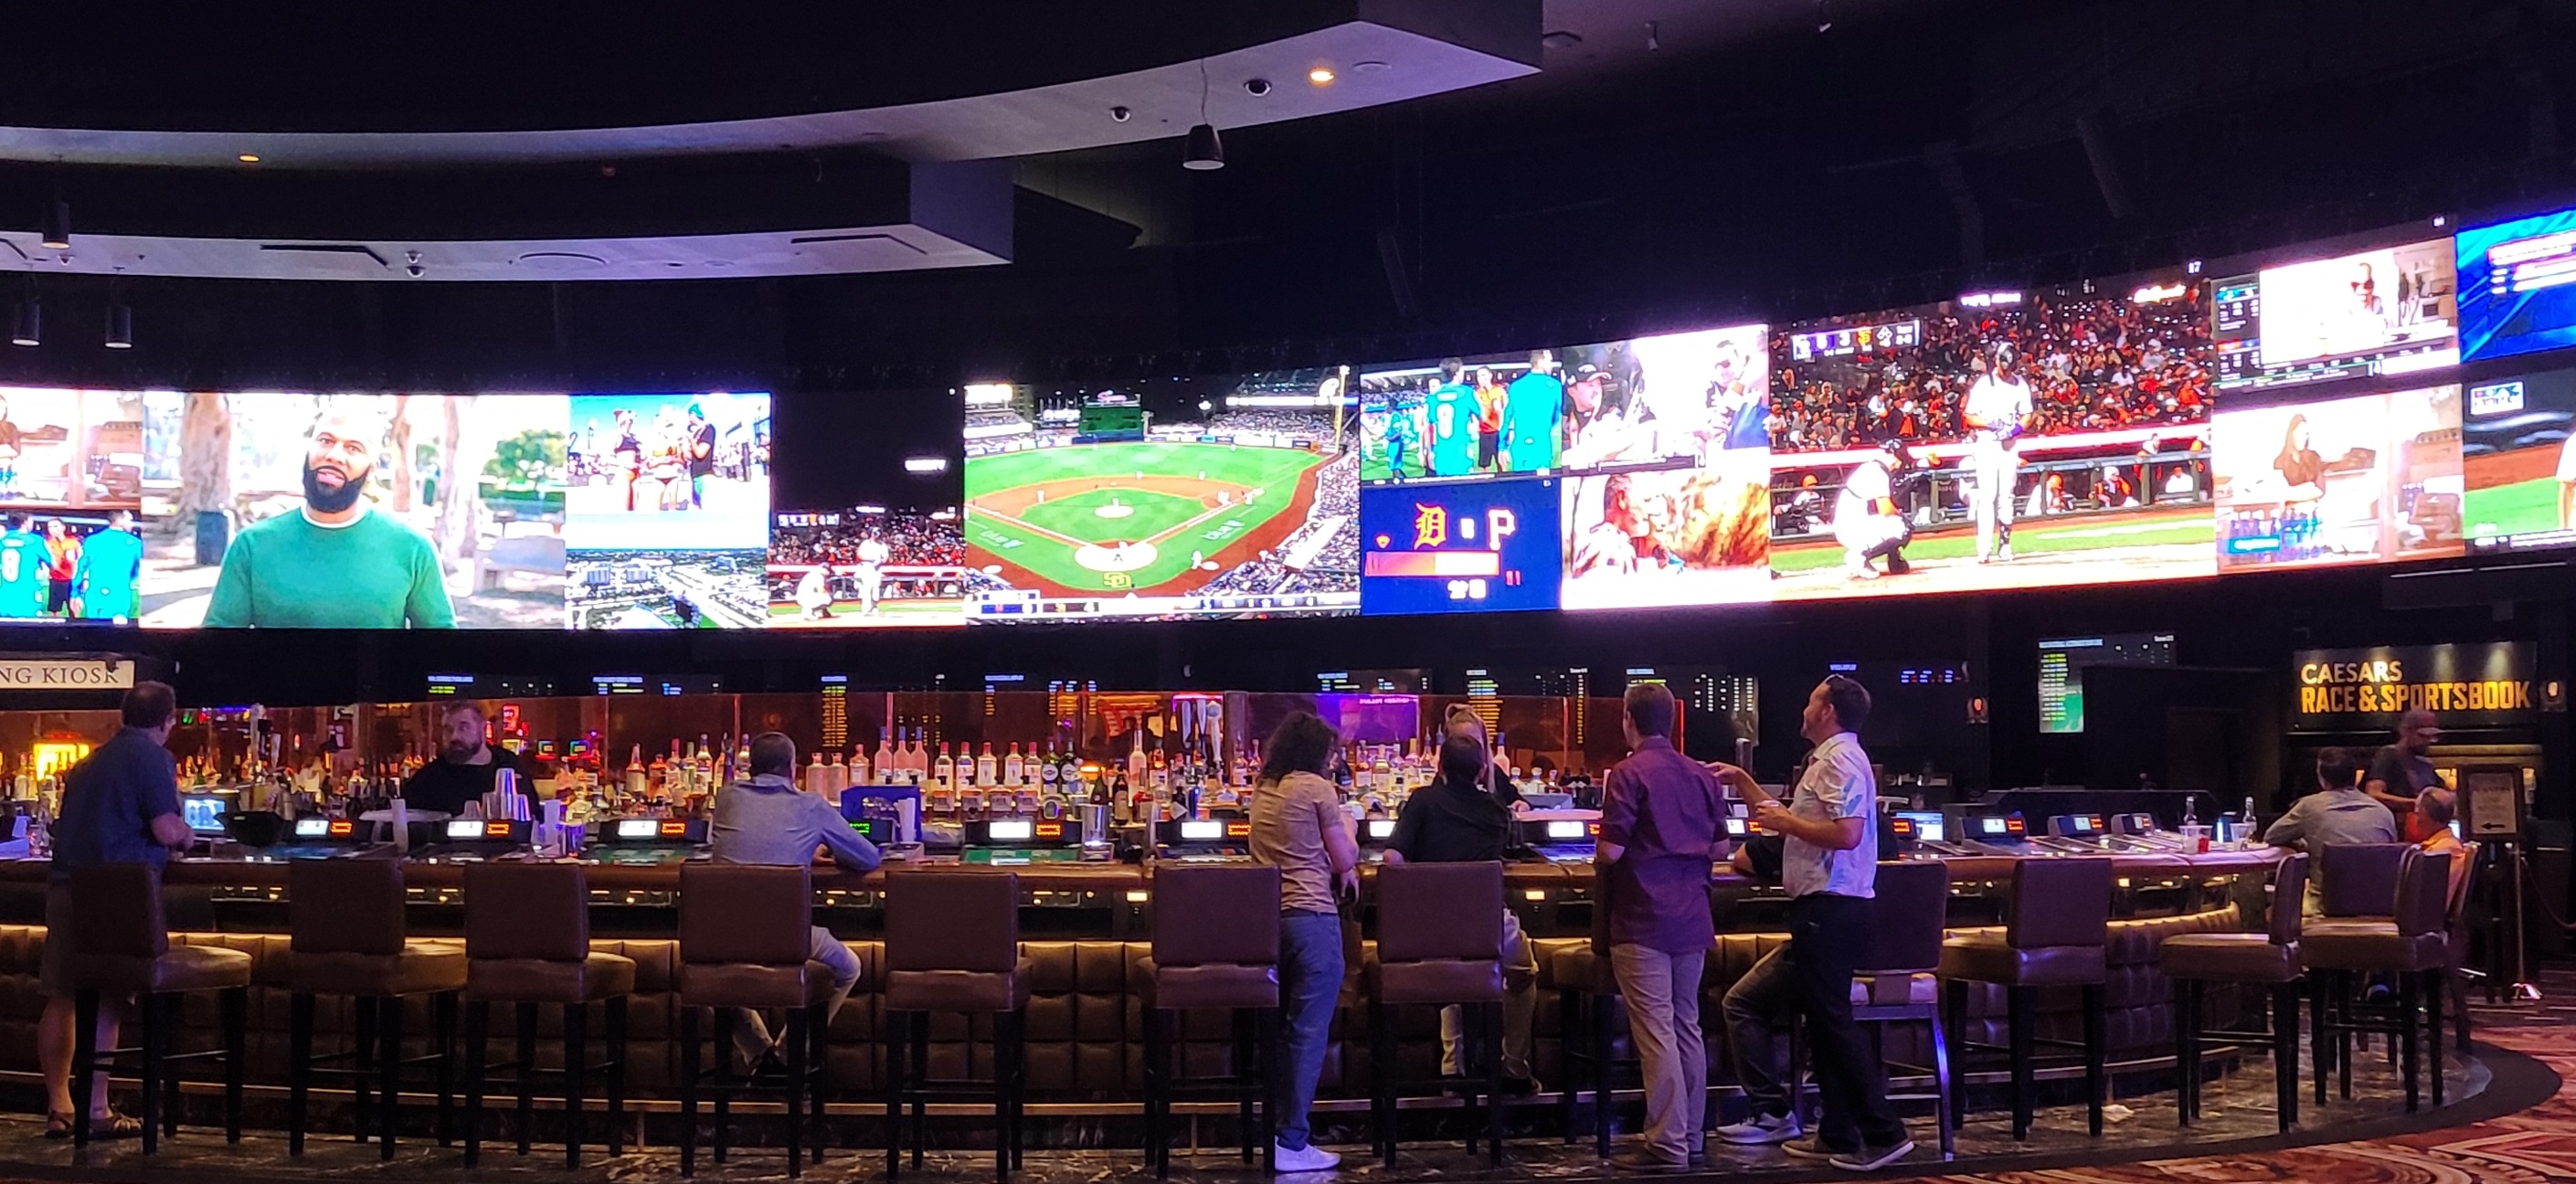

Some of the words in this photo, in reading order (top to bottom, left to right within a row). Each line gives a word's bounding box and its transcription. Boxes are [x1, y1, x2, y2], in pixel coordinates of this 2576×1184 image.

[1414, 502, 1447, 550] D
[1488, 508, 1516, 551] P
[0, 668, 32, 683] NG
[42, 667, 119, 683] KIOSK
[2301, 661, 2403, 684] CAESARS
[2301, 686, 2356, 713] RACE
[2359, 685, 2378, 712] &
[2380, 682, 2530, 712] SPORTSBOOK
